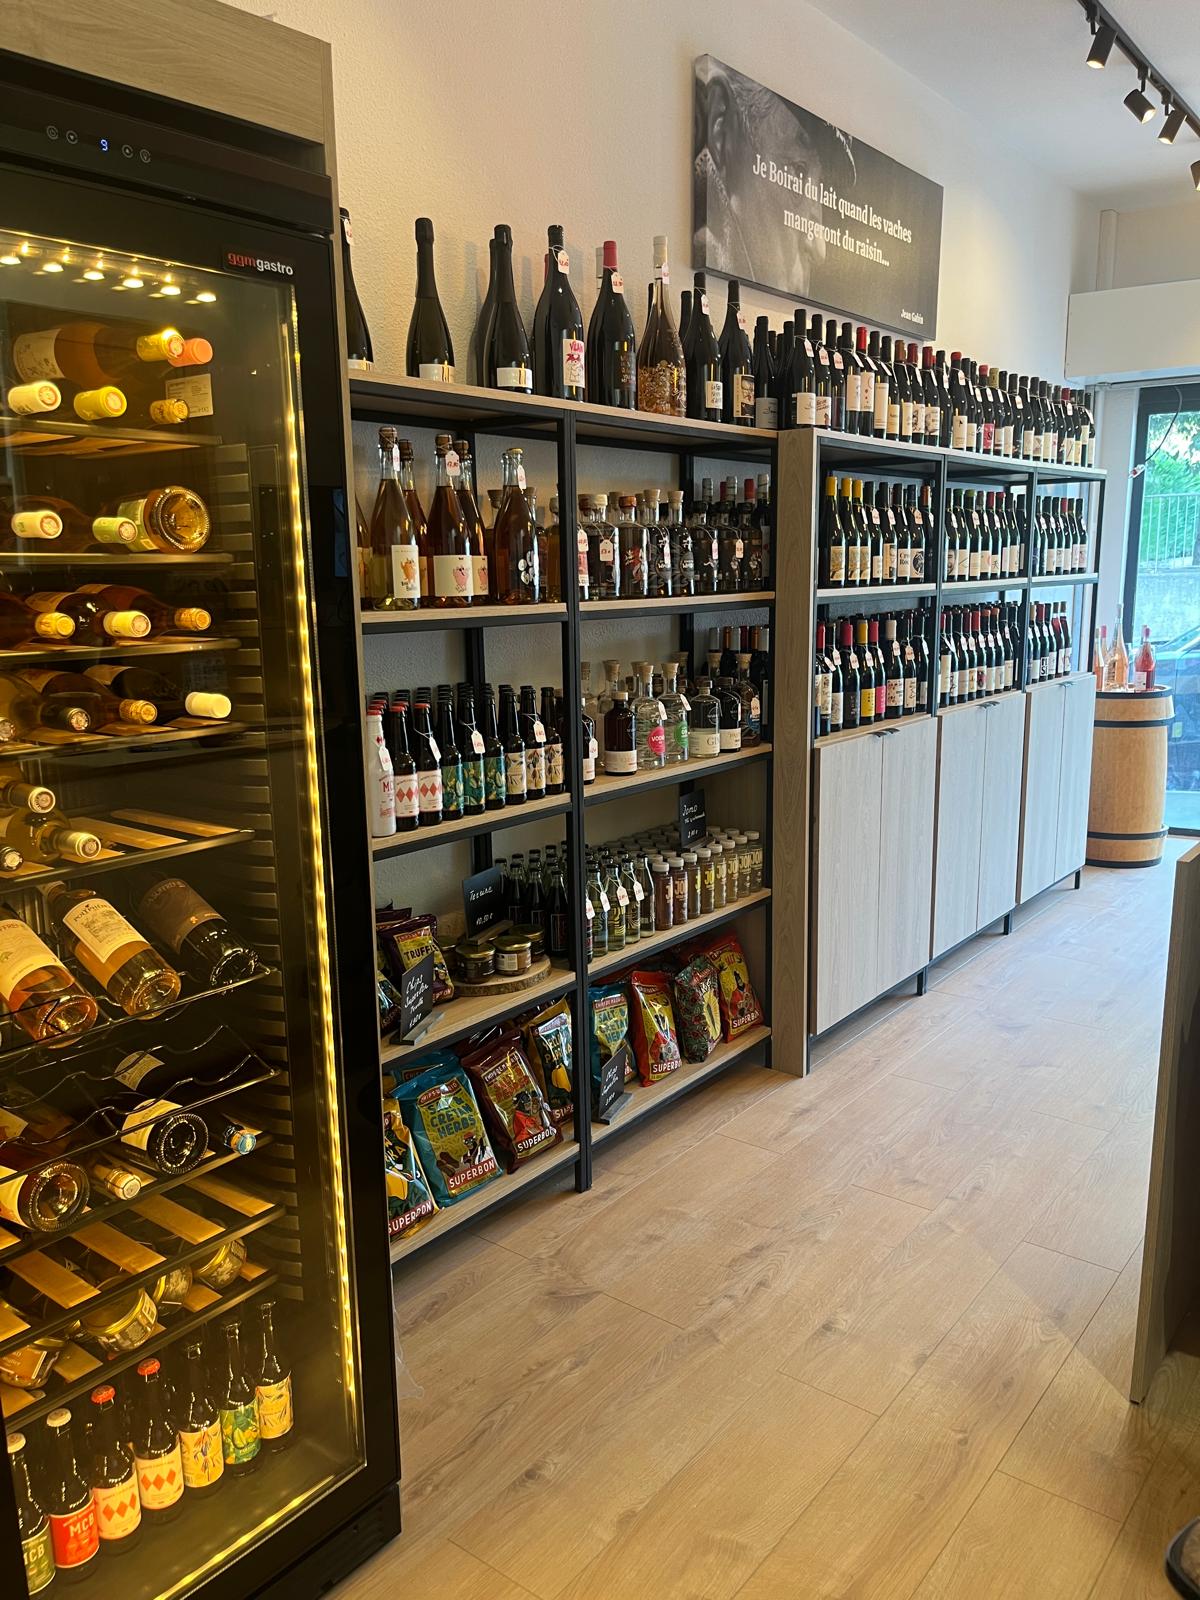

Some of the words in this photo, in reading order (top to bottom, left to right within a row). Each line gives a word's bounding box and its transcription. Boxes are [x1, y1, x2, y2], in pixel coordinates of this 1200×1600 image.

[752, 153, 768, 178] Je
[768, 160, 803, 195] Boirai
[804, 177, 818, 202] du
[819, 182, 837, 210] lait
[838, 197, 868, 226] quand
[869, 206, 882, 231] les
[882, 218, 912, 244] vaches
[783, 209, 841, 247] mangeront
[842, 229, 855, 253] du
[227, 251, 294, 276] ggmgastro
[900, 308, 911, 320] Jean
[448, 1159, 495, 1188] SUPERBON
[69, 1512, 95, 1537] MCB
